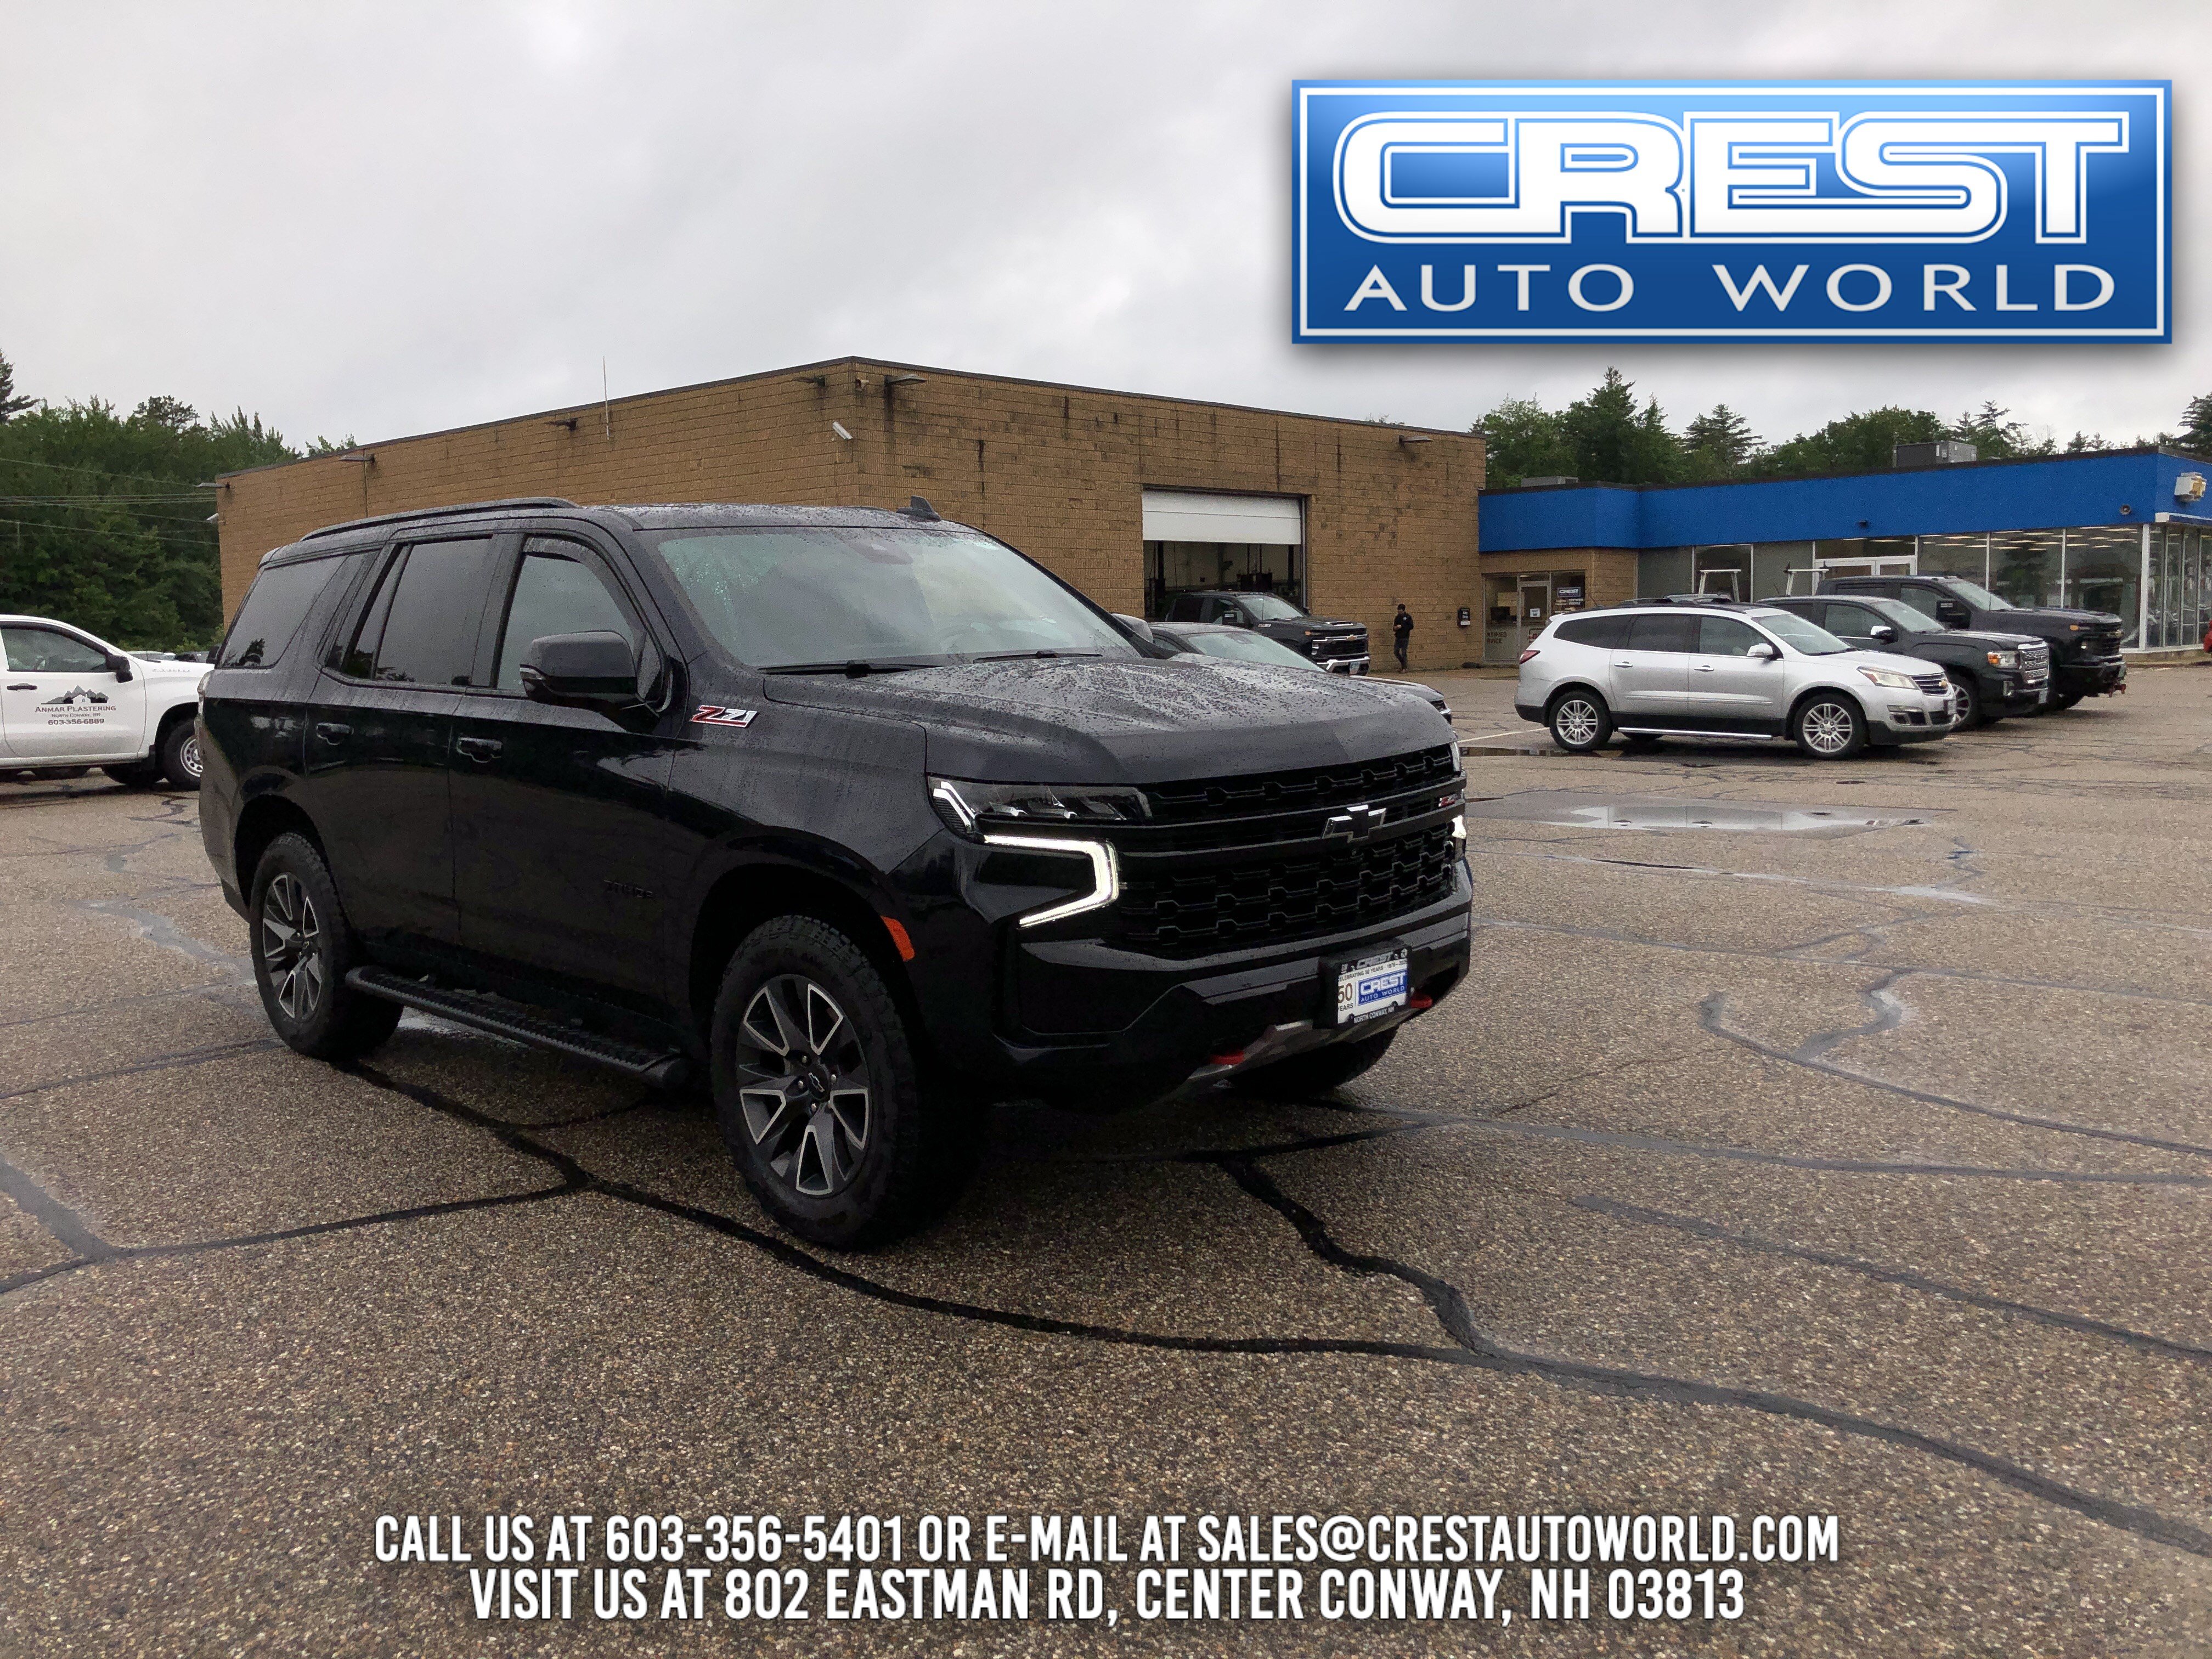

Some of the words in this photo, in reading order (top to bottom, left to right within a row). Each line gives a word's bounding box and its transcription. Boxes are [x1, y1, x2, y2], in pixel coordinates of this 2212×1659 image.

[690, 704, 758, 727] Z71
[1338, 983, 1353, 1003] 50
[1361, 972, 1406, 996] CREST
[1361, 992, 1378, 1002] AUTO
[1382, 986, 1405, 996] WORLD
